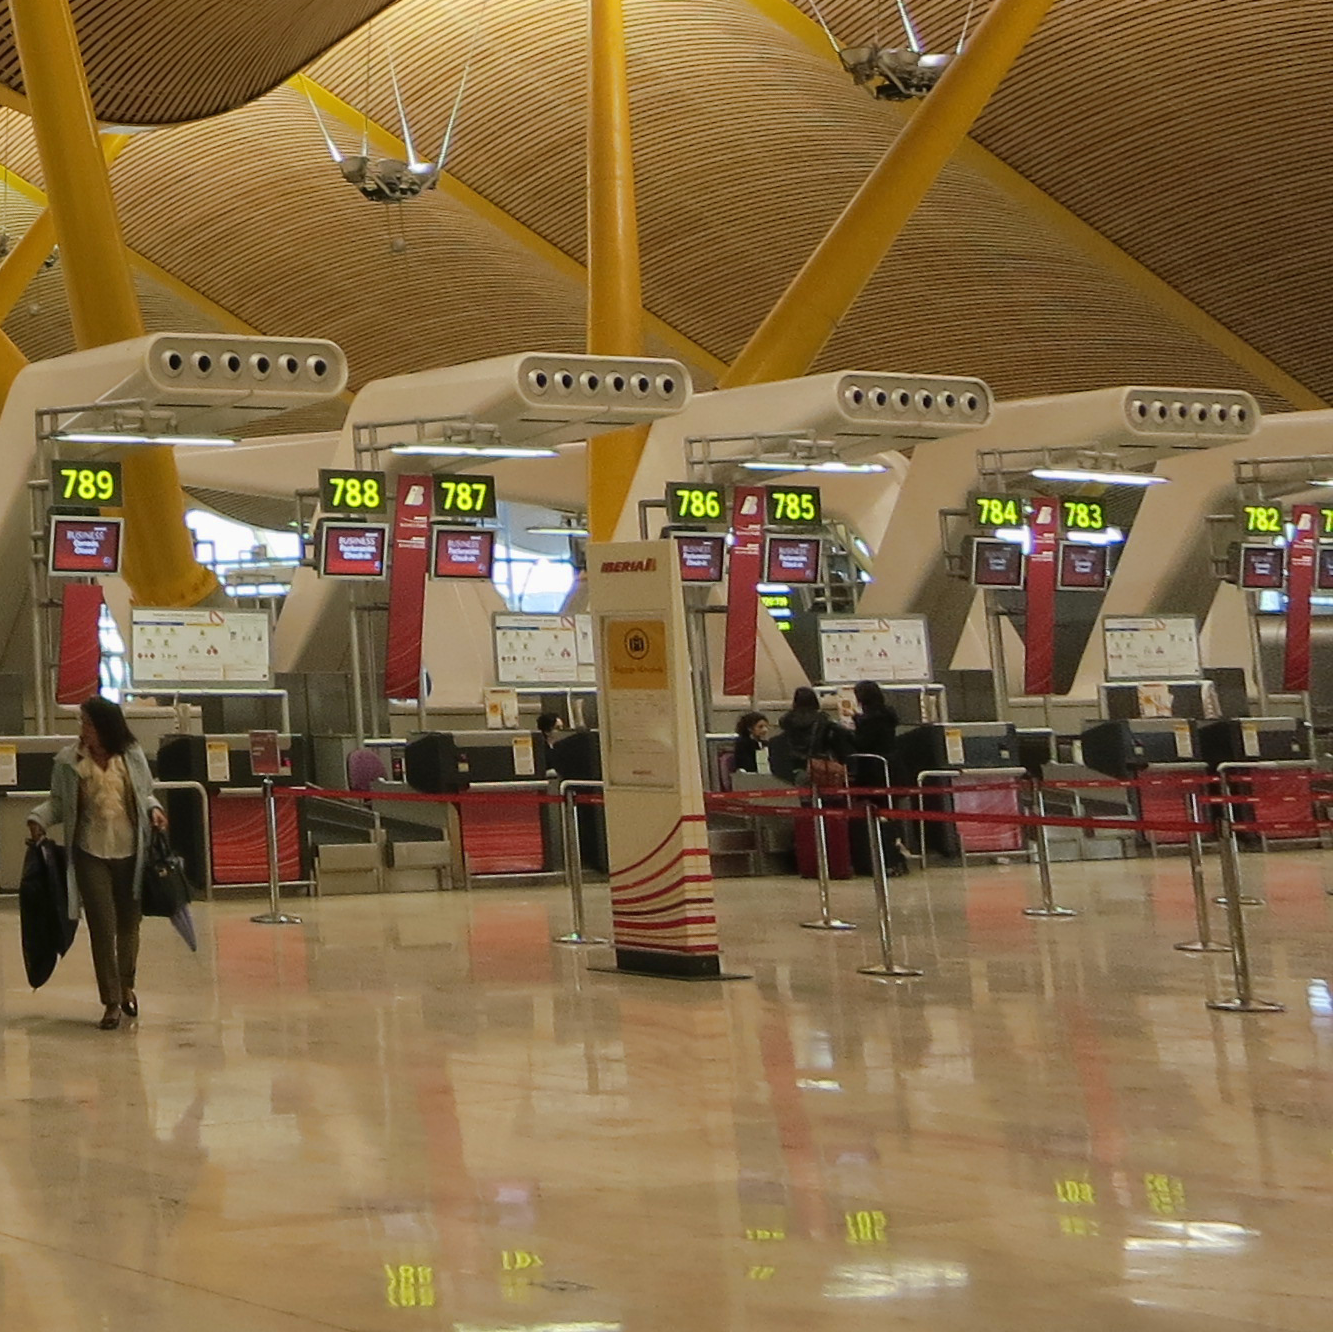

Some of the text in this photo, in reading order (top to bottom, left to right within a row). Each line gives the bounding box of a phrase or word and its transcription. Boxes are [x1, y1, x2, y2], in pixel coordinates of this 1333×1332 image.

[61, 470, 113, 499] 789
[330, 478, 379, 507] 788
[442, 483, 486, 510] 787
[677, 490, 719, 517] 786
[773, 493, 814, 519] 785
[978, 499, 1017, 524] 784
[1065, 503, 1102, 528] 783
[1245, 507, 1280, 531] 782
[600, 561, 644, 573] IBERIA
